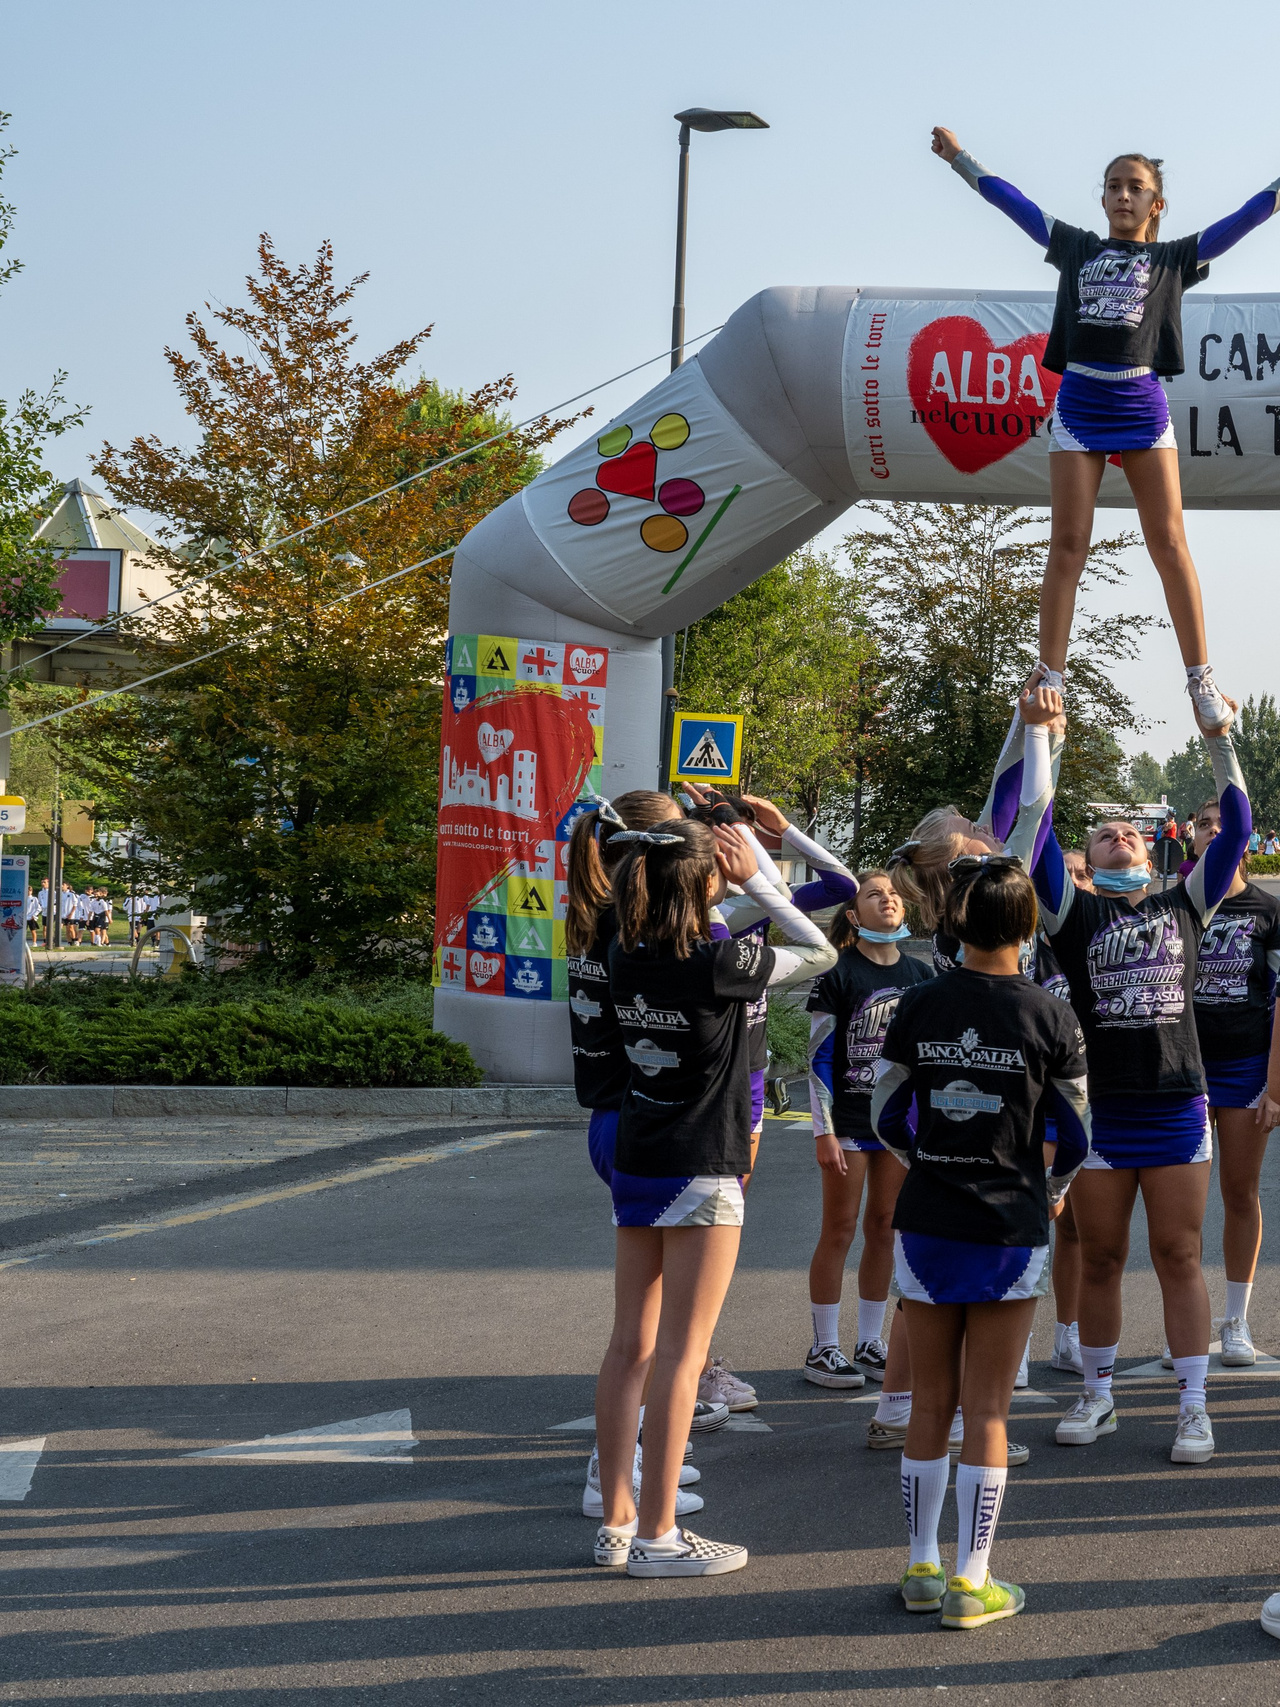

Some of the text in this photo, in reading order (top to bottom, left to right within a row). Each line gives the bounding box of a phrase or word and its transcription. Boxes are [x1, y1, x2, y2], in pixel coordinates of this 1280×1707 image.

[1105, 302, 1145, 314] SEASON
[927, 350, 1046, 407] ALBA
[861, 312, 890, 480] Corri sotto le torri
[910, 401, 951, 424] nel
[574, 656, 597, 669] ALBA
[482, 733, 506, 748] ALBA
[454, 823, 479, 838] sotto
[483, 824, 494, 839] le
[498, 827, 529, 843] torri
[1096, 912, 1172, 969] JUST
[473, 960, 494, 975] ALBA
[1091, 965, 1185, 988] CHEERLEADING
[1134, 991, 1185, 1004] SEASON
[917, 1042, 1026, 1067] BANCA D'ALBA
[976, 1483, 999, 1551] TITANS
[915, 1566, 931, 1575] 1968
